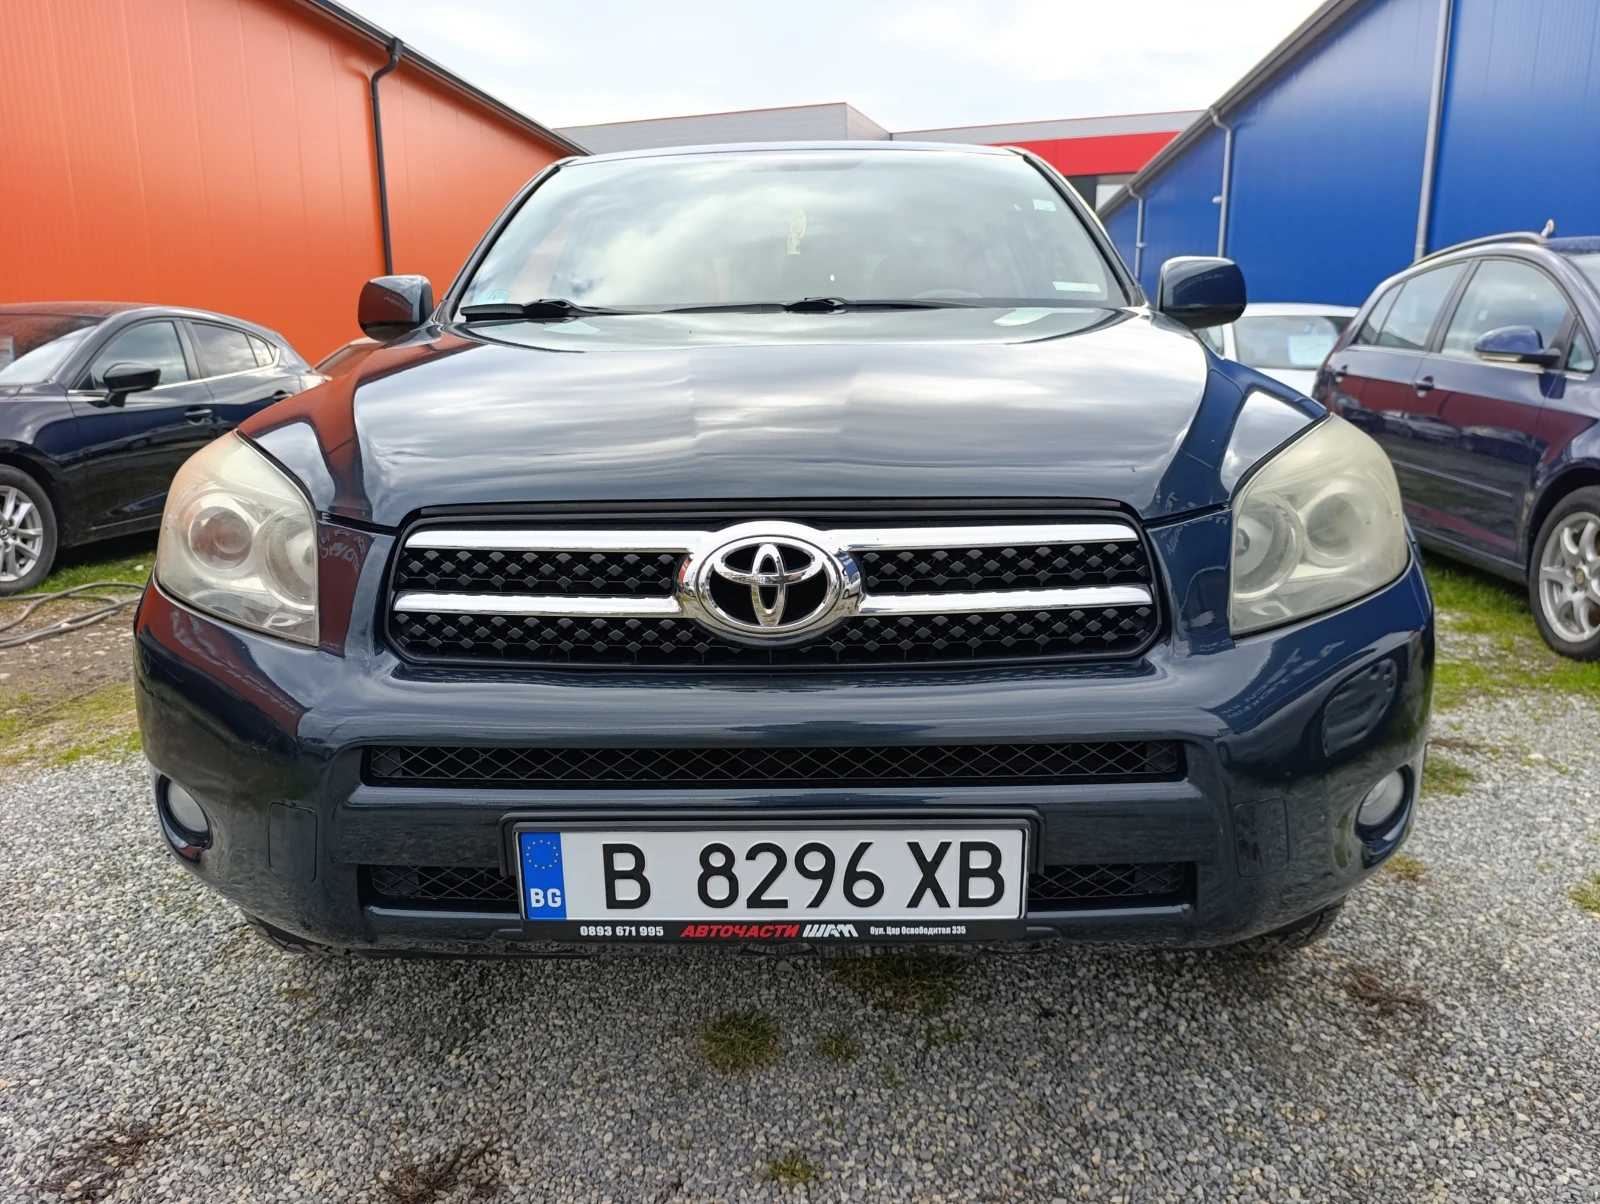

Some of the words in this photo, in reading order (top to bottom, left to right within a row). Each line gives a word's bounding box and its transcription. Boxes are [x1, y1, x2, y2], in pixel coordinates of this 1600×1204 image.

[698, 841, 885, 909] 8296
[530, 888, 562, 908] BG
[580, 926, 612, 936] 0893
[616, 926, 636, 936] 671
[640, 926, 664, 936] 995
[680, 925, 799, 938] АВТОЧАСТИ
[887, 926, 899, 936] Цар
[901, 926, 950, 936] Освободител
[952, 926, 966, 934] 335
